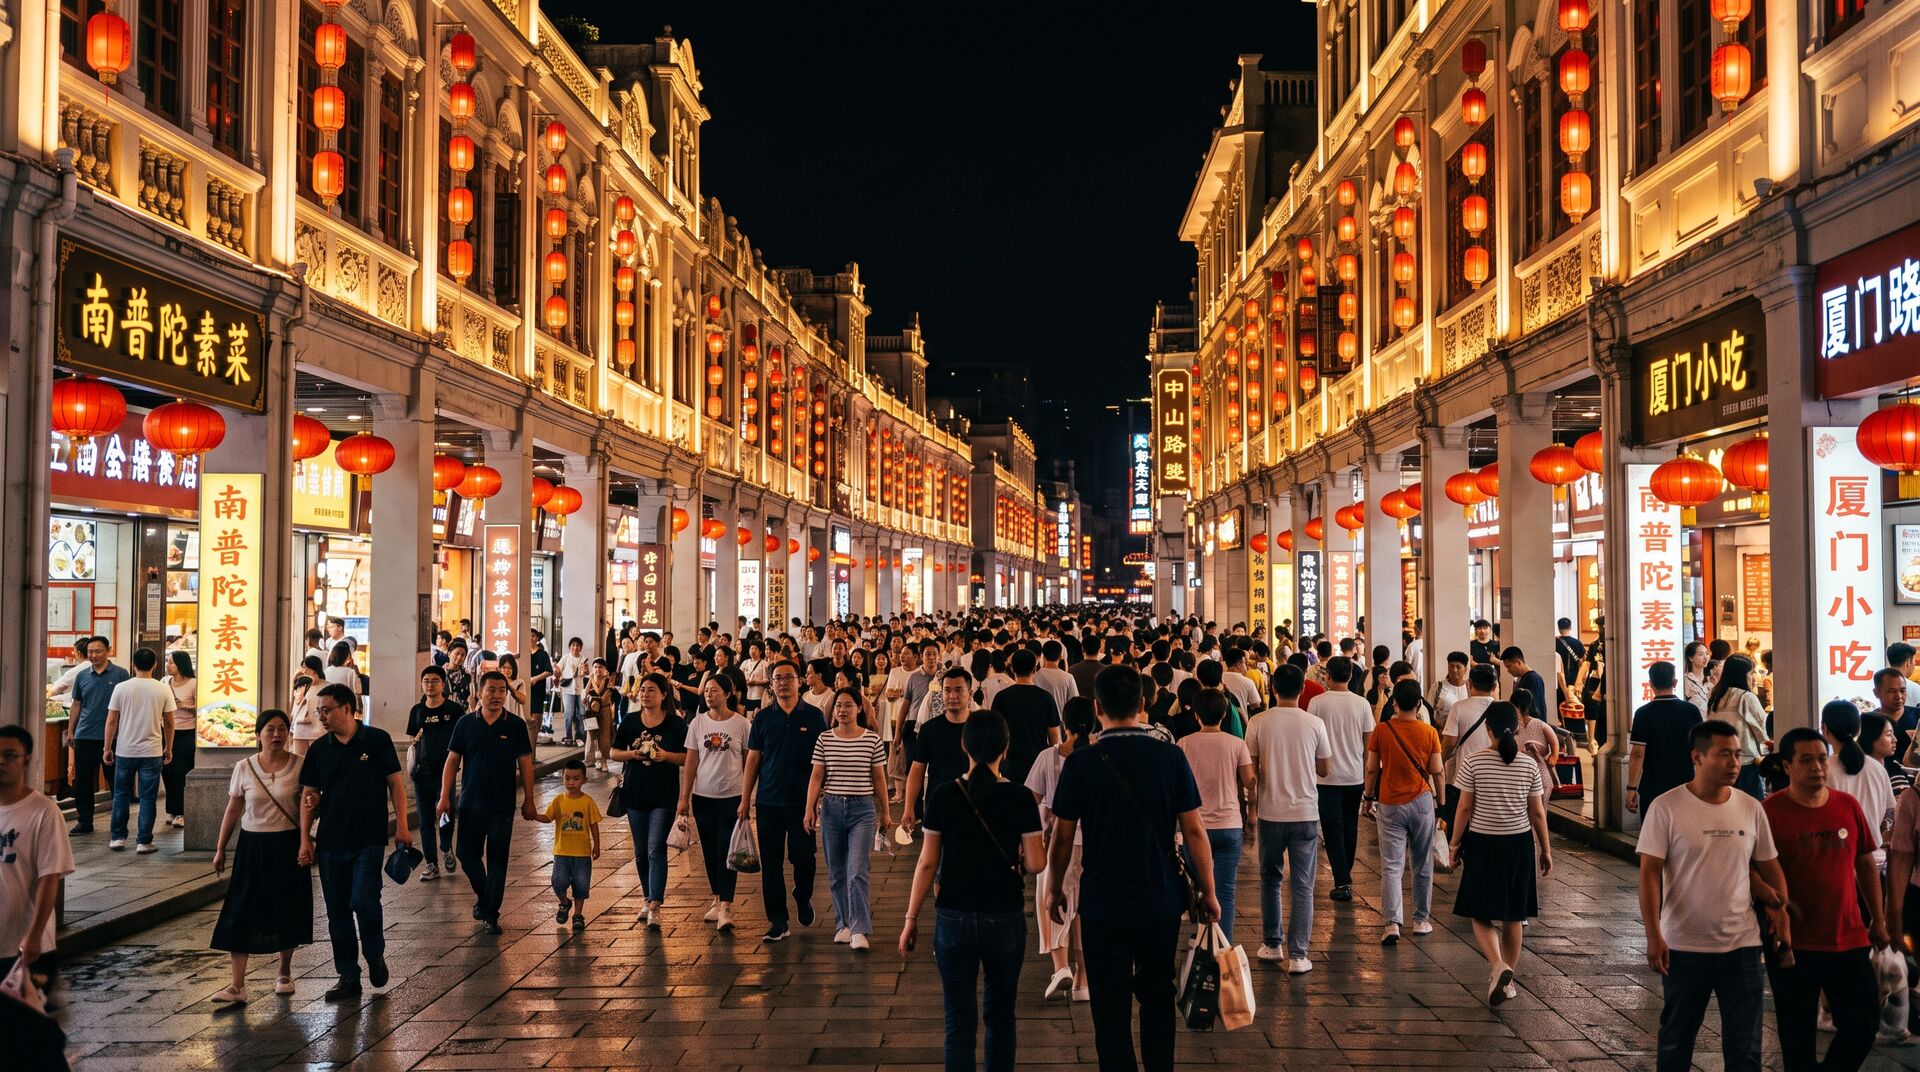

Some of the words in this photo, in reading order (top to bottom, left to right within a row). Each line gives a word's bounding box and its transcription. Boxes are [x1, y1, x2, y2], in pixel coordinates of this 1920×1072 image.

[82, 272, 251, 386] 南普陀素菜
[1649, 329, 1748, 416] 厦门小吃
[211, 484, 248, 696] 南普陀素菜
[1825, 476, 1873, 681] 厦门小吃
